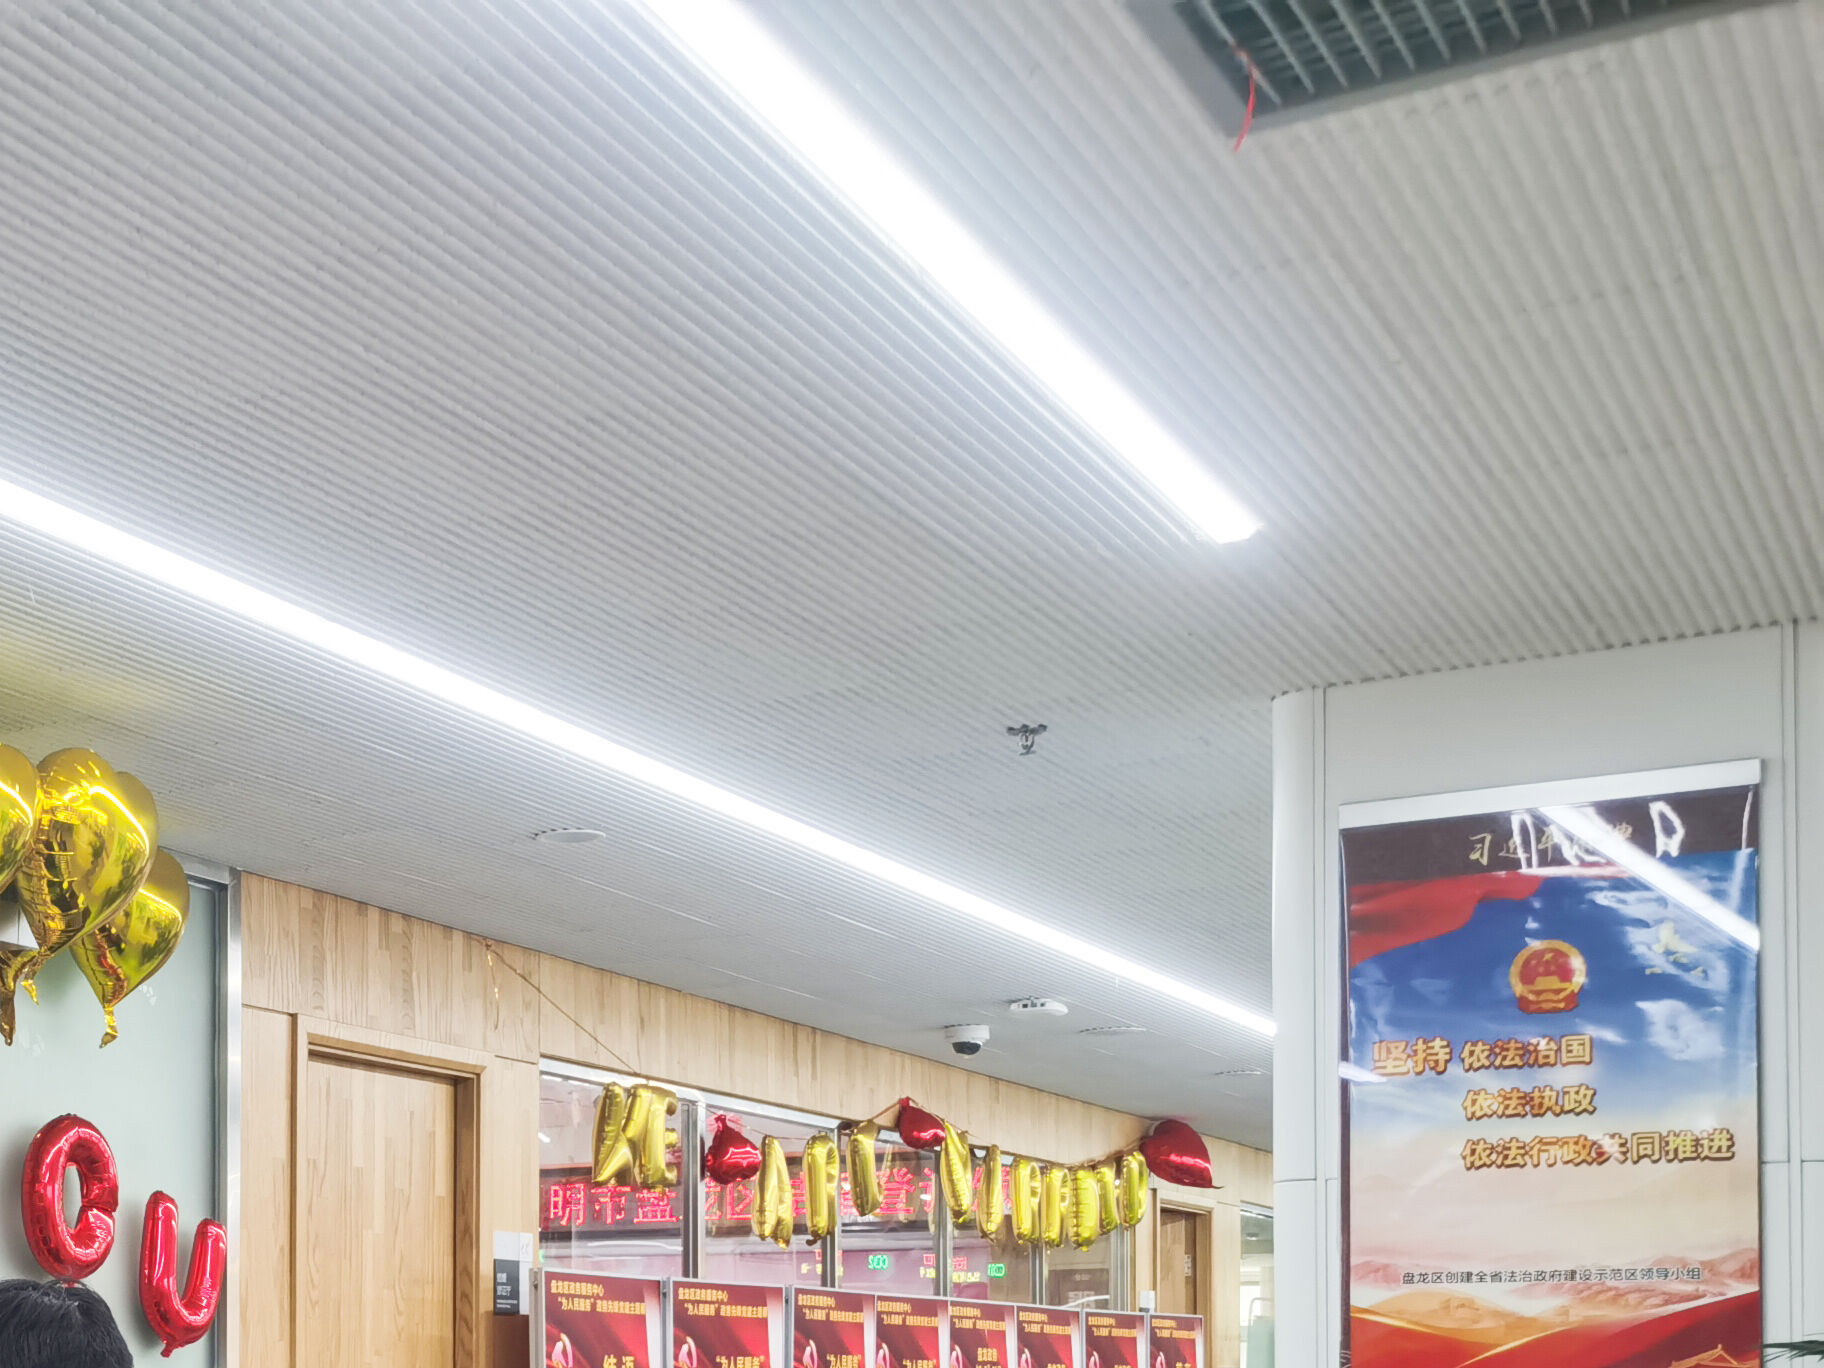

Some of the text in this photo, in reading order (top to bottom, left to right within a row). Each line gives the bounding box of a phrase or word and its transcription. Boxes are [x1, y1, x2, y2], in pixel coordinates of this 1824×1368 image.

[1372, 1033, 1594, 1076] 坚持 依法治国
[1462, 1084, 1597, 1121] 依法执政
[1462, 1127, 1735, 1169] 依法行政共同推进
[1401, 1265, 1703, 1287] 盘龙区创建全省法治政府建设示范区领导小组
